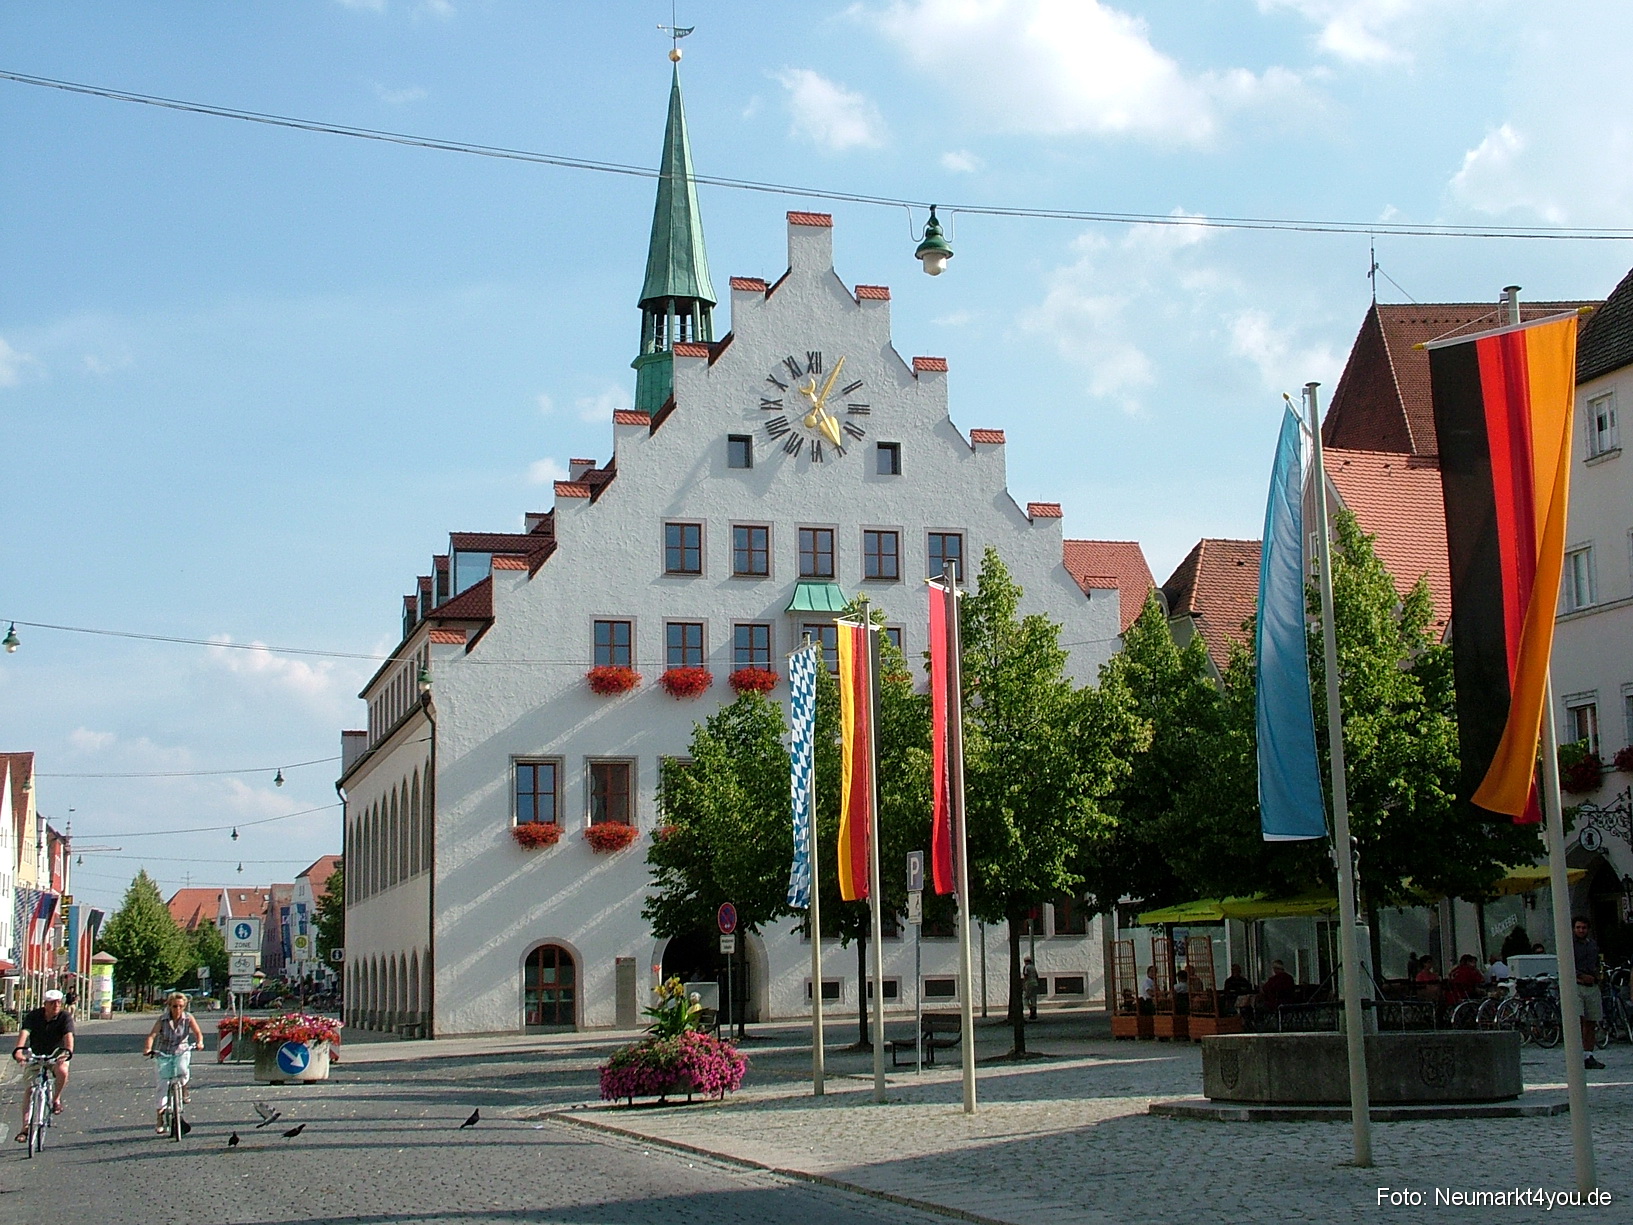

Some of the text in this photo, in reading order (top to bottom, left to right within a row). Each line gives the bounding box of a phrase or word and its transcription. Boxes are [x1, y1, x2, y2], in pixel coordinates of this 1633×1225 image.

[782, 355, 803, 380] XI
[807, 351, 822, 374] XII
[766, 373, 789, 392] X
[847, 403, 871, 415] III
[811, 440, 824, 463] VI
[910, 856, 920, 886] P
